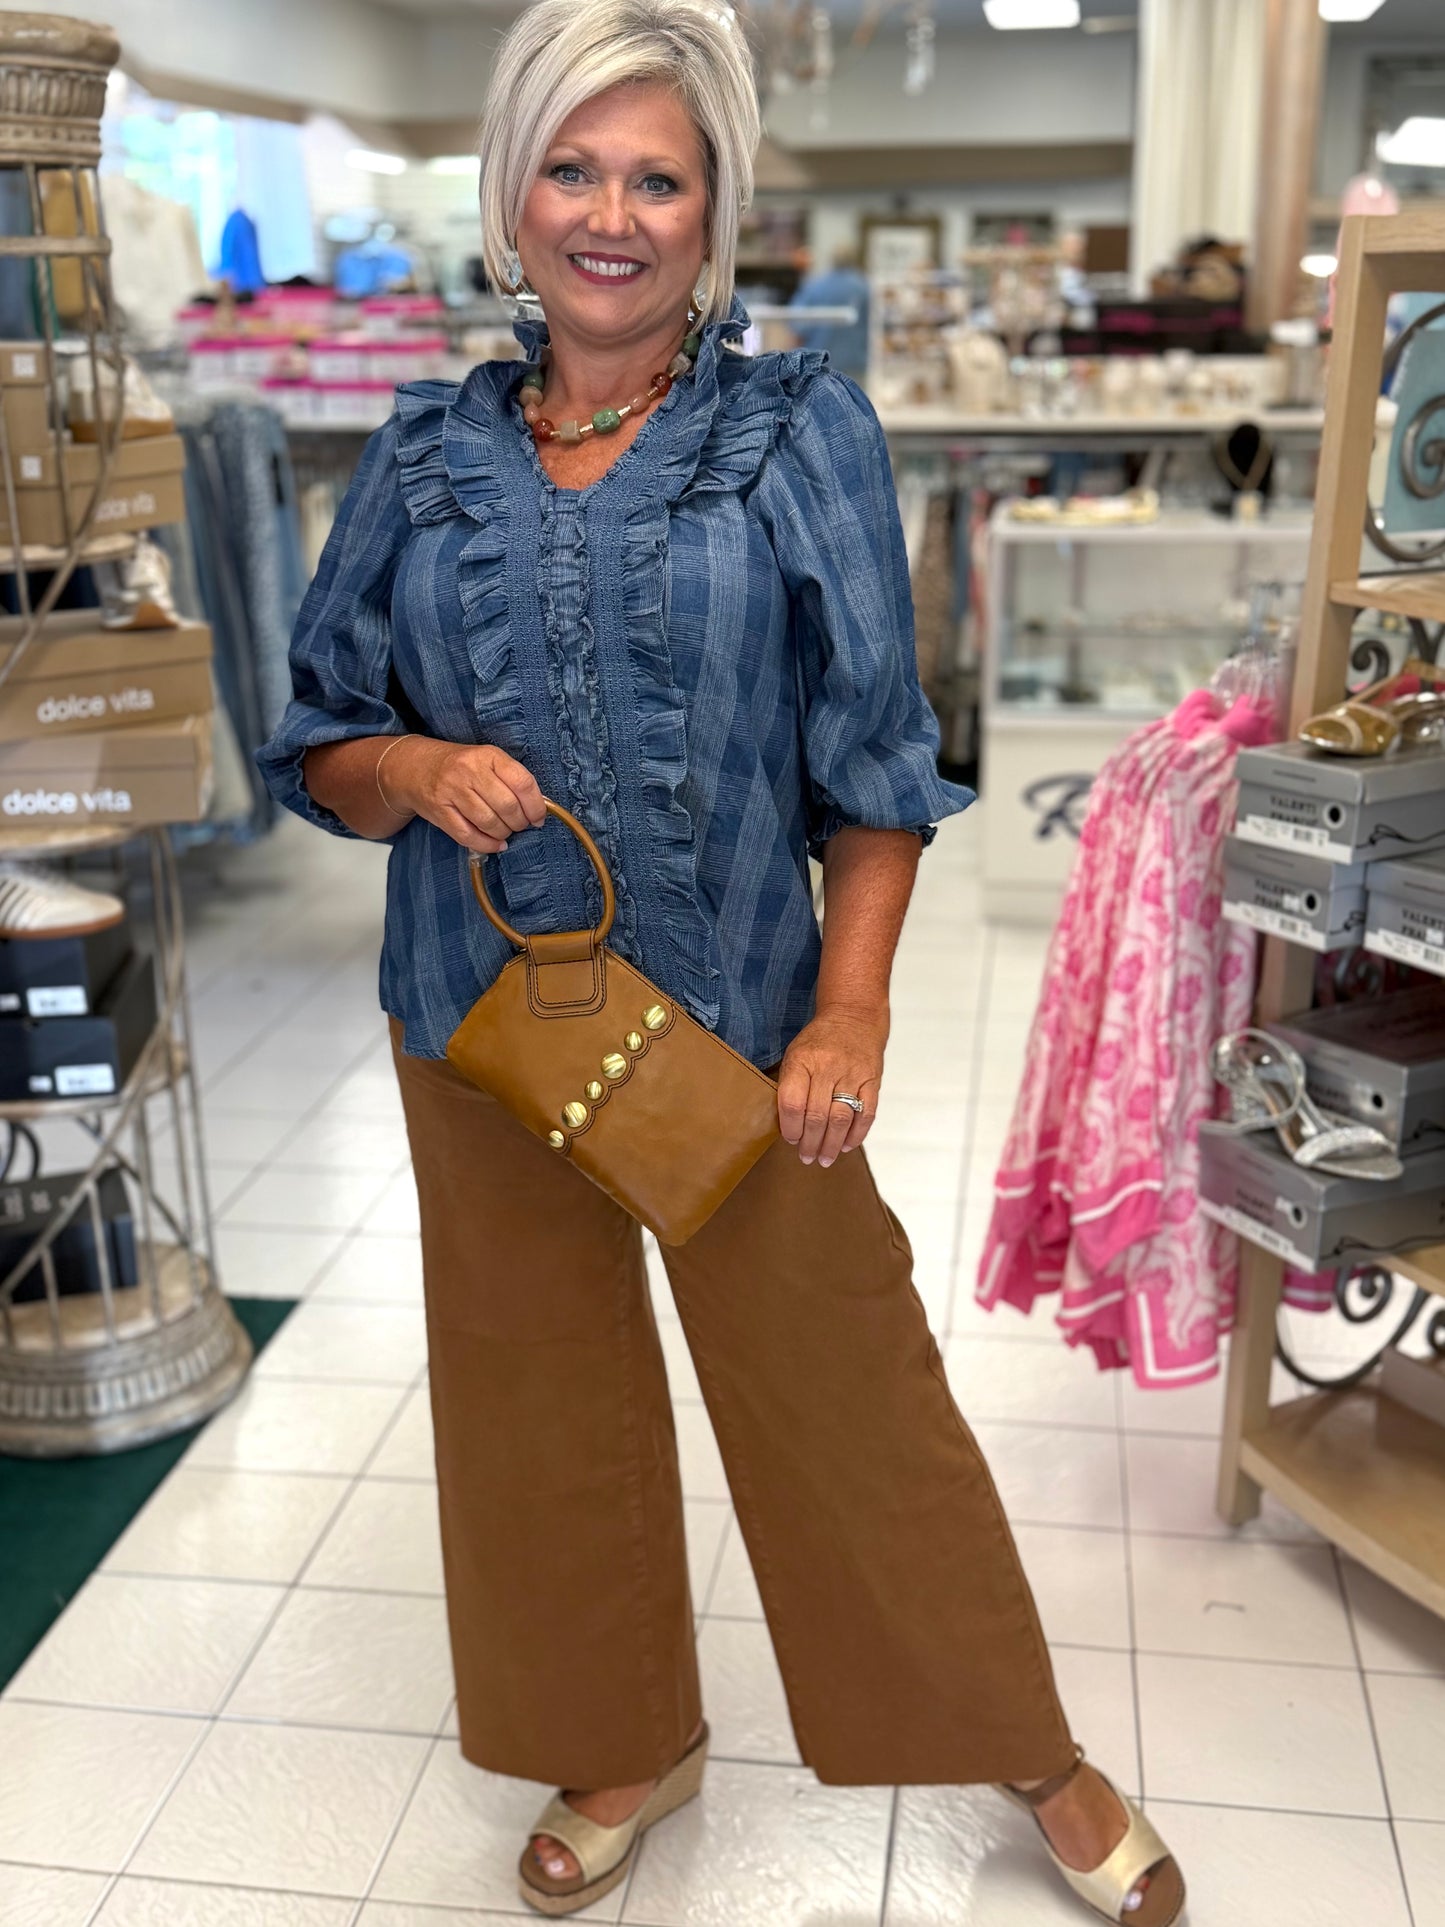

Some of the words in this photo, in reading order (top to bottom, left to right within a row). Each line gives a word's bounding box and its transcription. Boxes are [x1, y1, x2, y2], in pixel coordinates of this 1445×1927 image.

[37, 697, 106, 723] dolce
[110, 689, 154, 713] vita
[3, 789, 78, 815] dolce
[81, 788, 132, 812] vita
